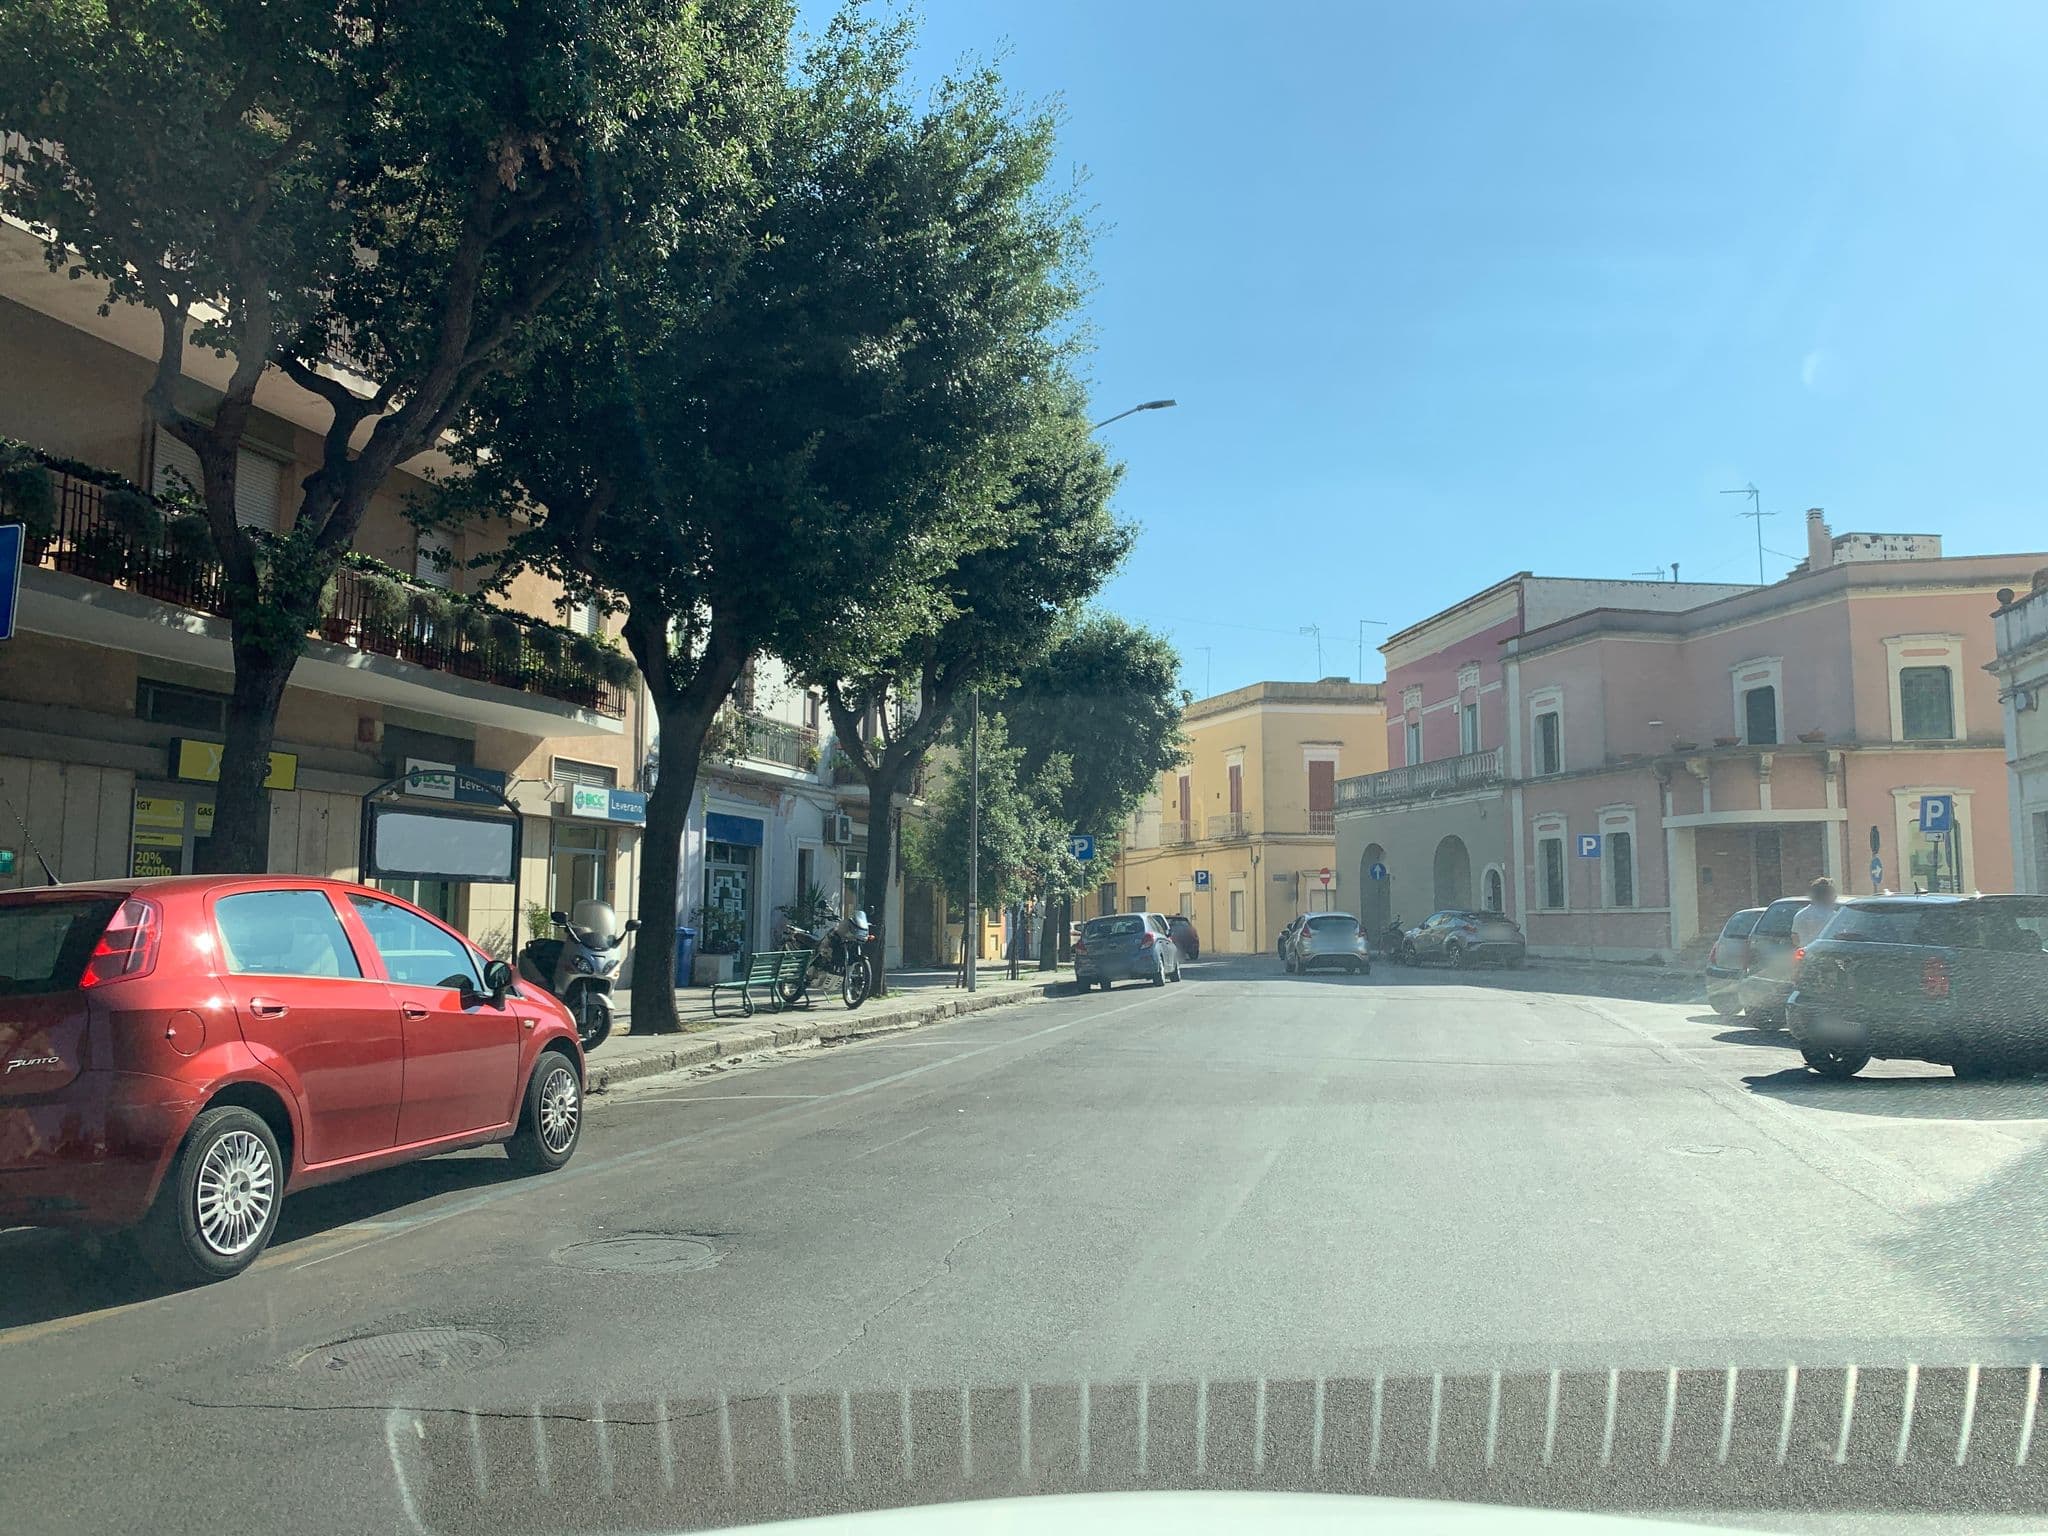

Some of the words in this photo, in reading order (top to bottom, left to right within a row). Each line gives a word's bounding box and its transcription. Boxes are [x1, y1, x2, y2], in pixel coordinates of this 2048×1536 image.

[197, 807, 213, 817] GAS
[611, 798, 643, 814] Leverano
[1926, 800, 1945, 828] P
[1073, 838, 1089, 858] P
[1582, 837, 1597, 856] P
[136, 851, 162, 865] 20%
[134, 864, 173, 877] sconto
[1197, 871, 1206, 884] P
